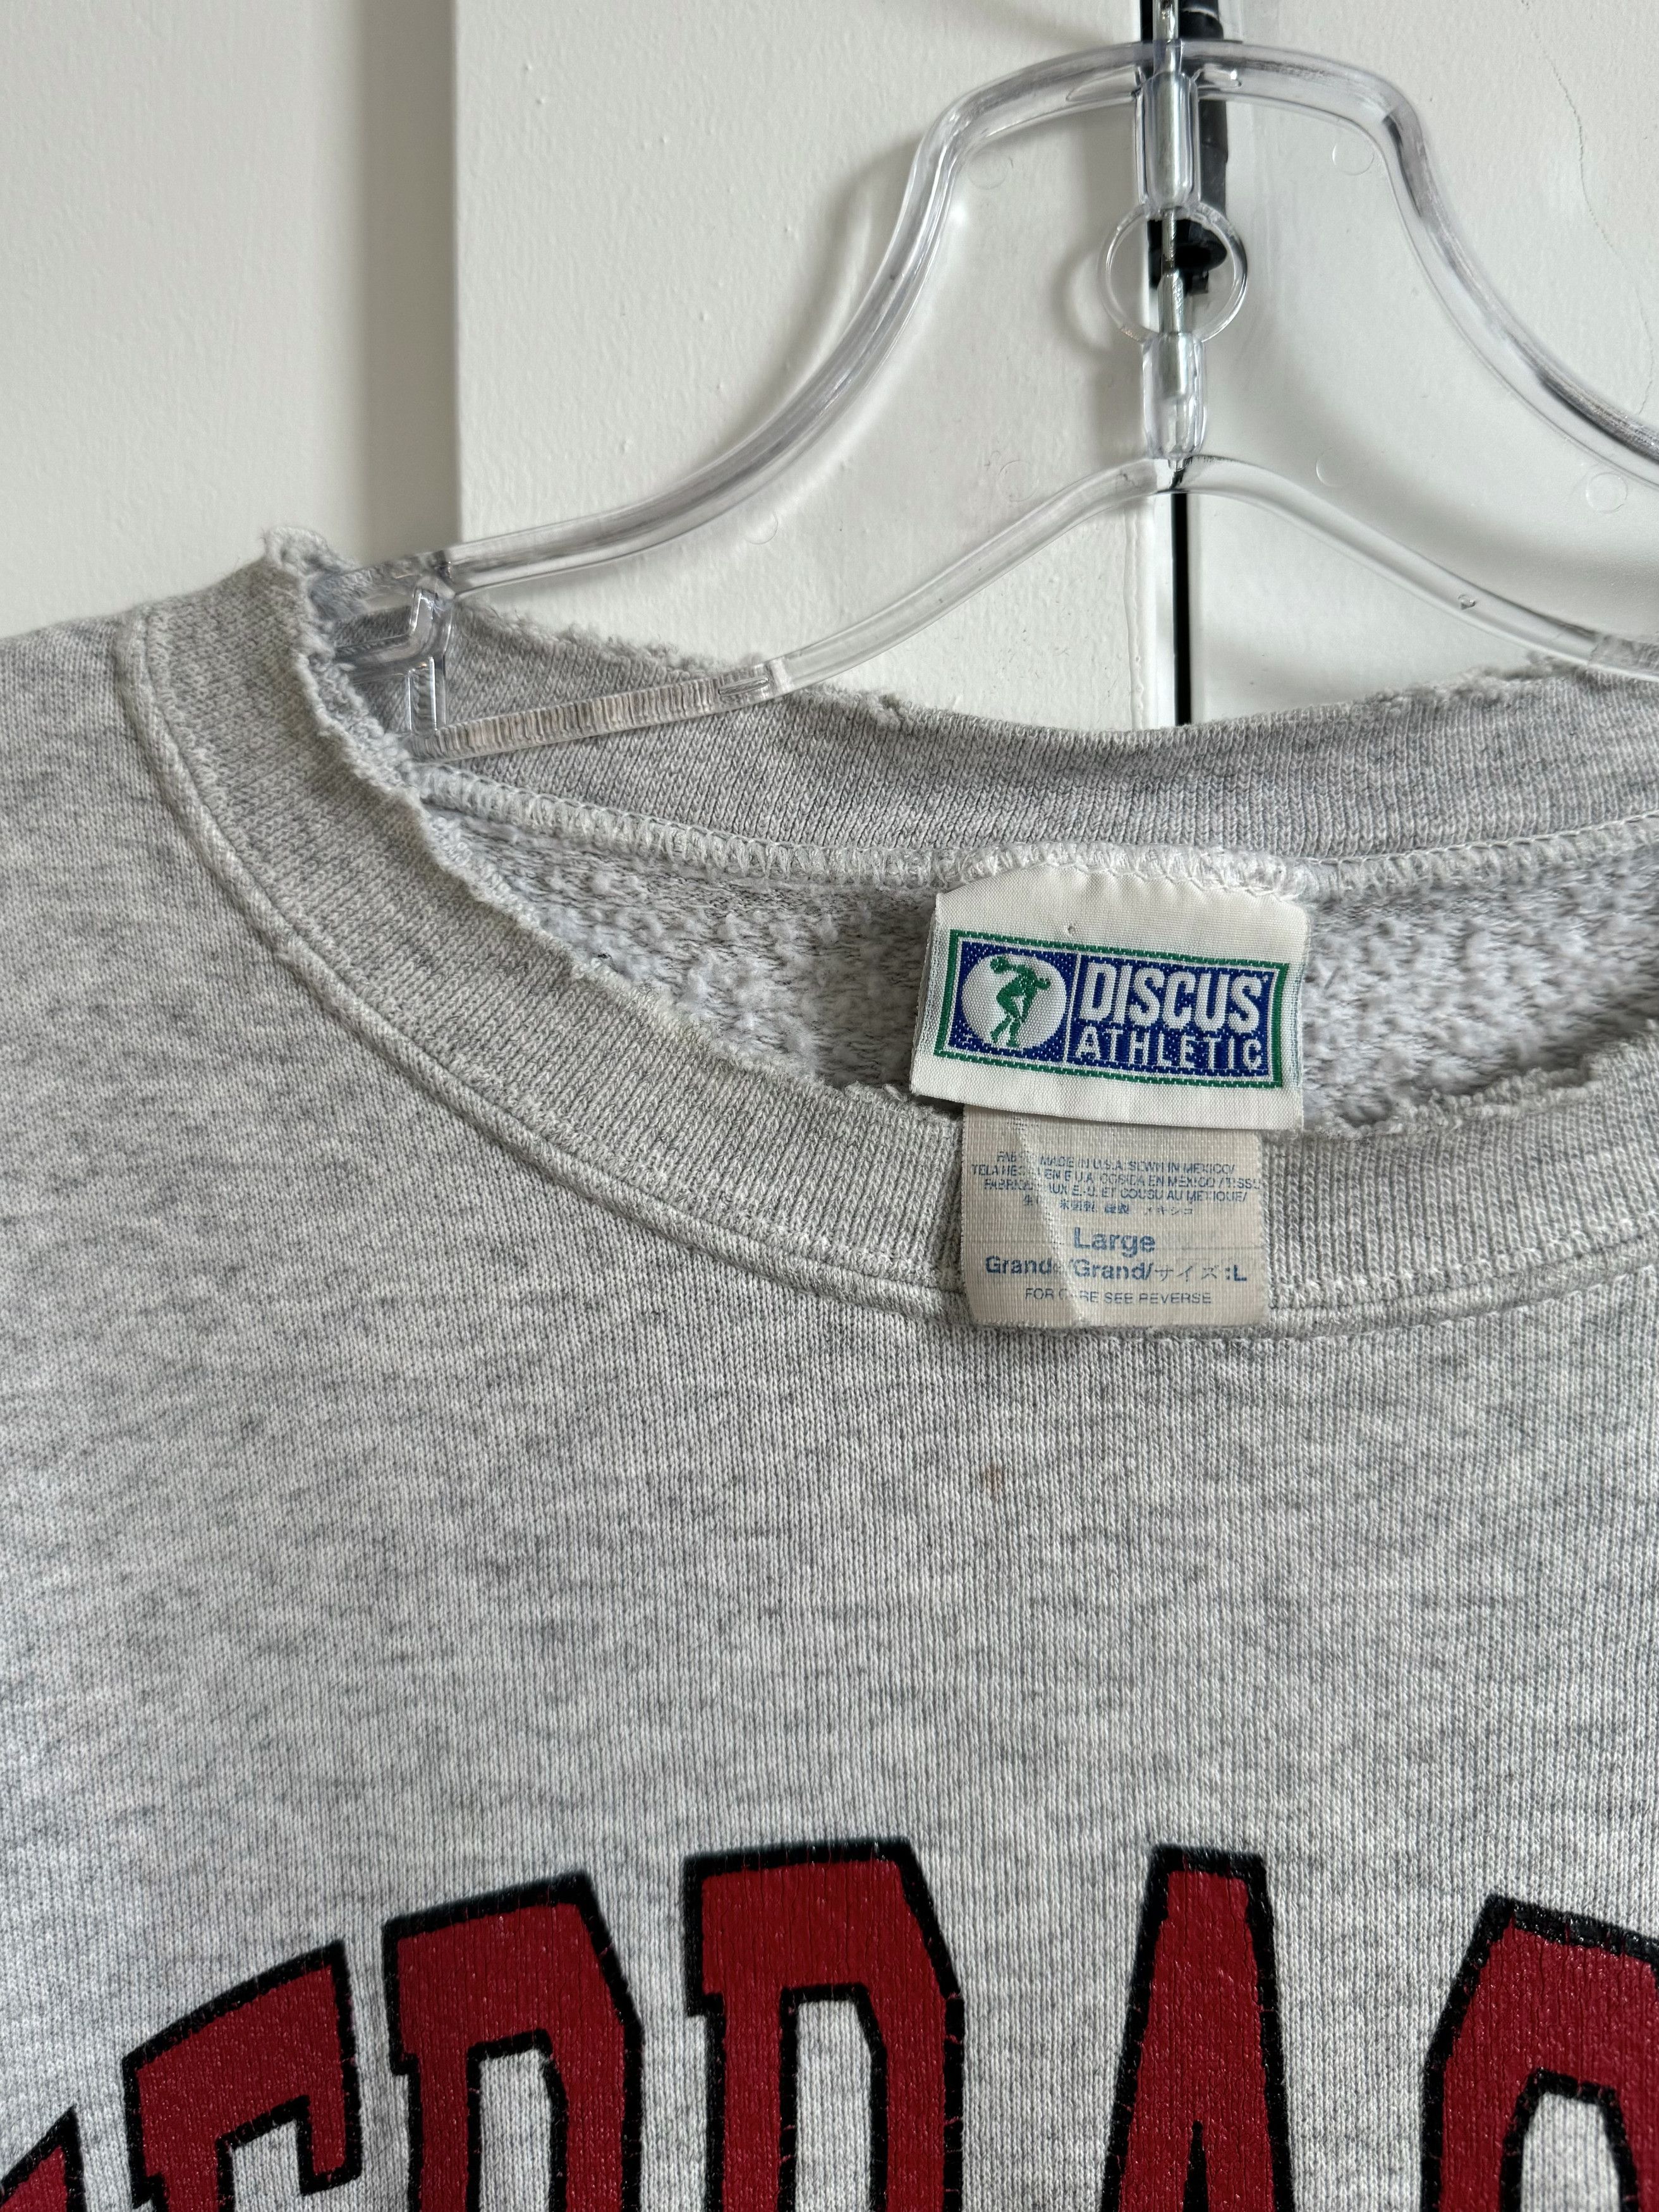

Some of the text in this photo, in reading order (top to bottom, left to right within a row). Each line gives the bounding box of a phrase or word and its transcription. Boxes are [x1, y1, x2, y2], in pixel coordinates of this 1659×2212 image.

[1078, 962, 1263, 1033] DISCUS
[1075, 1026, 1262, 1069] ATHLETIC
[971, 1164, 999, 1176] TELA
[1045, 1169, 1060, 1181] EN
[1149, 1175, 1164, 1186] EN
[1040, 1155, 1074, 1168] MADE
[1078, 1158, 1090, 1169] IN
[1168, 1162, 1180, 1173] IN
[1102, 1187, 1116, 1198] ET
[1167, 1189, 1182, 1201] AU
[1074, 1227, 1155, 1258] Large
[1025, 1287, 1212, 1304] FOR CRE SEE REVERSE
